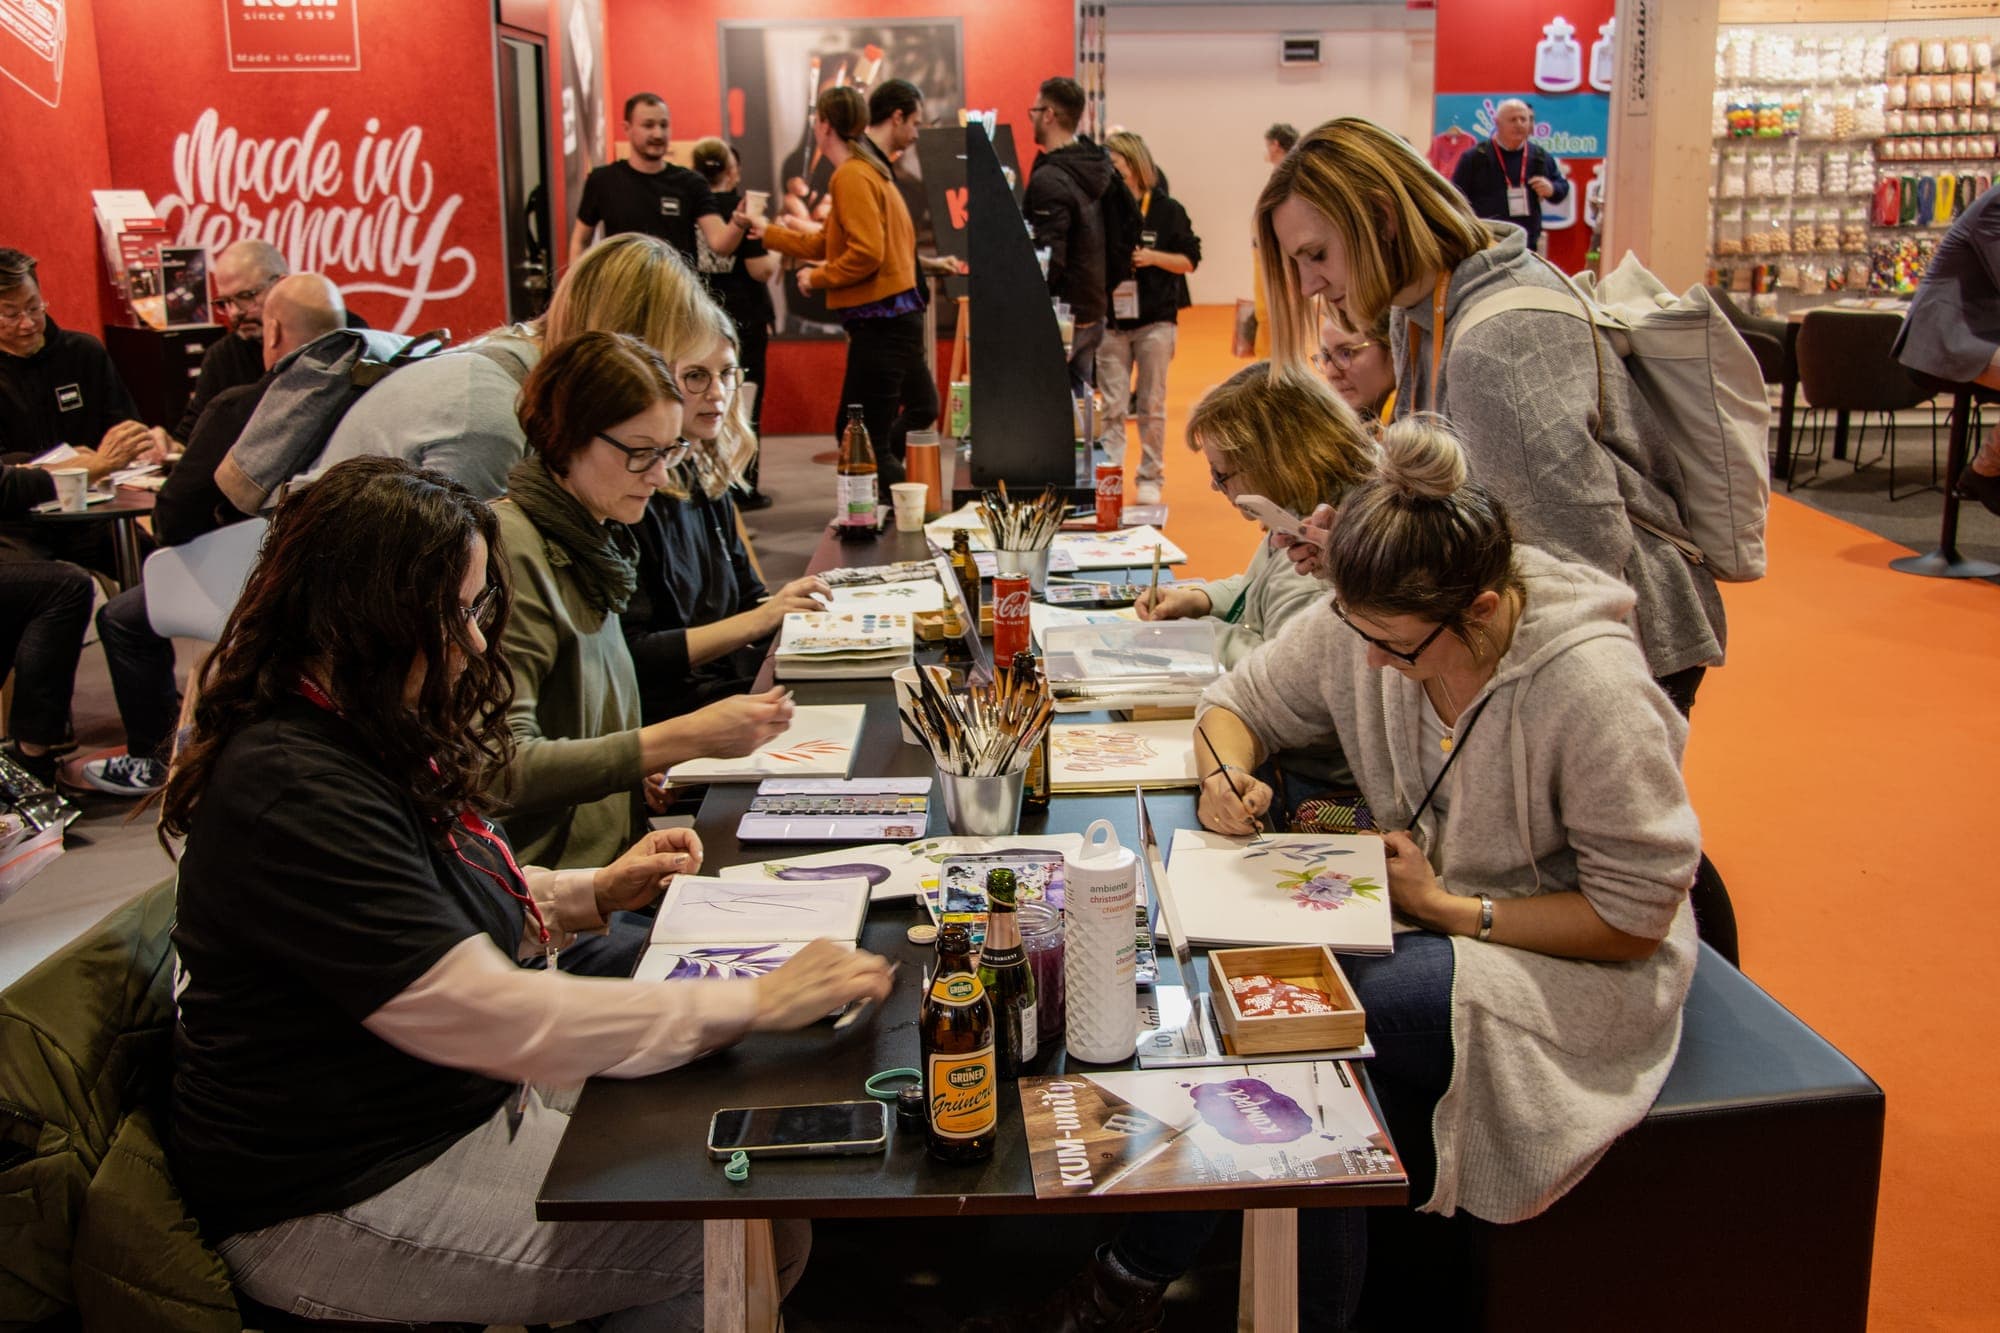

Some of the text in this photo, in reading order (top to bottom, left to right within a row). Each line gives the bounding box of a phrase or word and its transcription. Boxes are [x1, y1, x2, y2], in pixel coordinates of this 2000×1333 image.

[243, 10, 336, 21] since 1919
[294, 53, 351, 64] Germany
[173, 107, 434, 214] Made in
[1089, 882, 1128, 893] ambiente
[1035, 1080, 1094, 1186] KUM-unity
